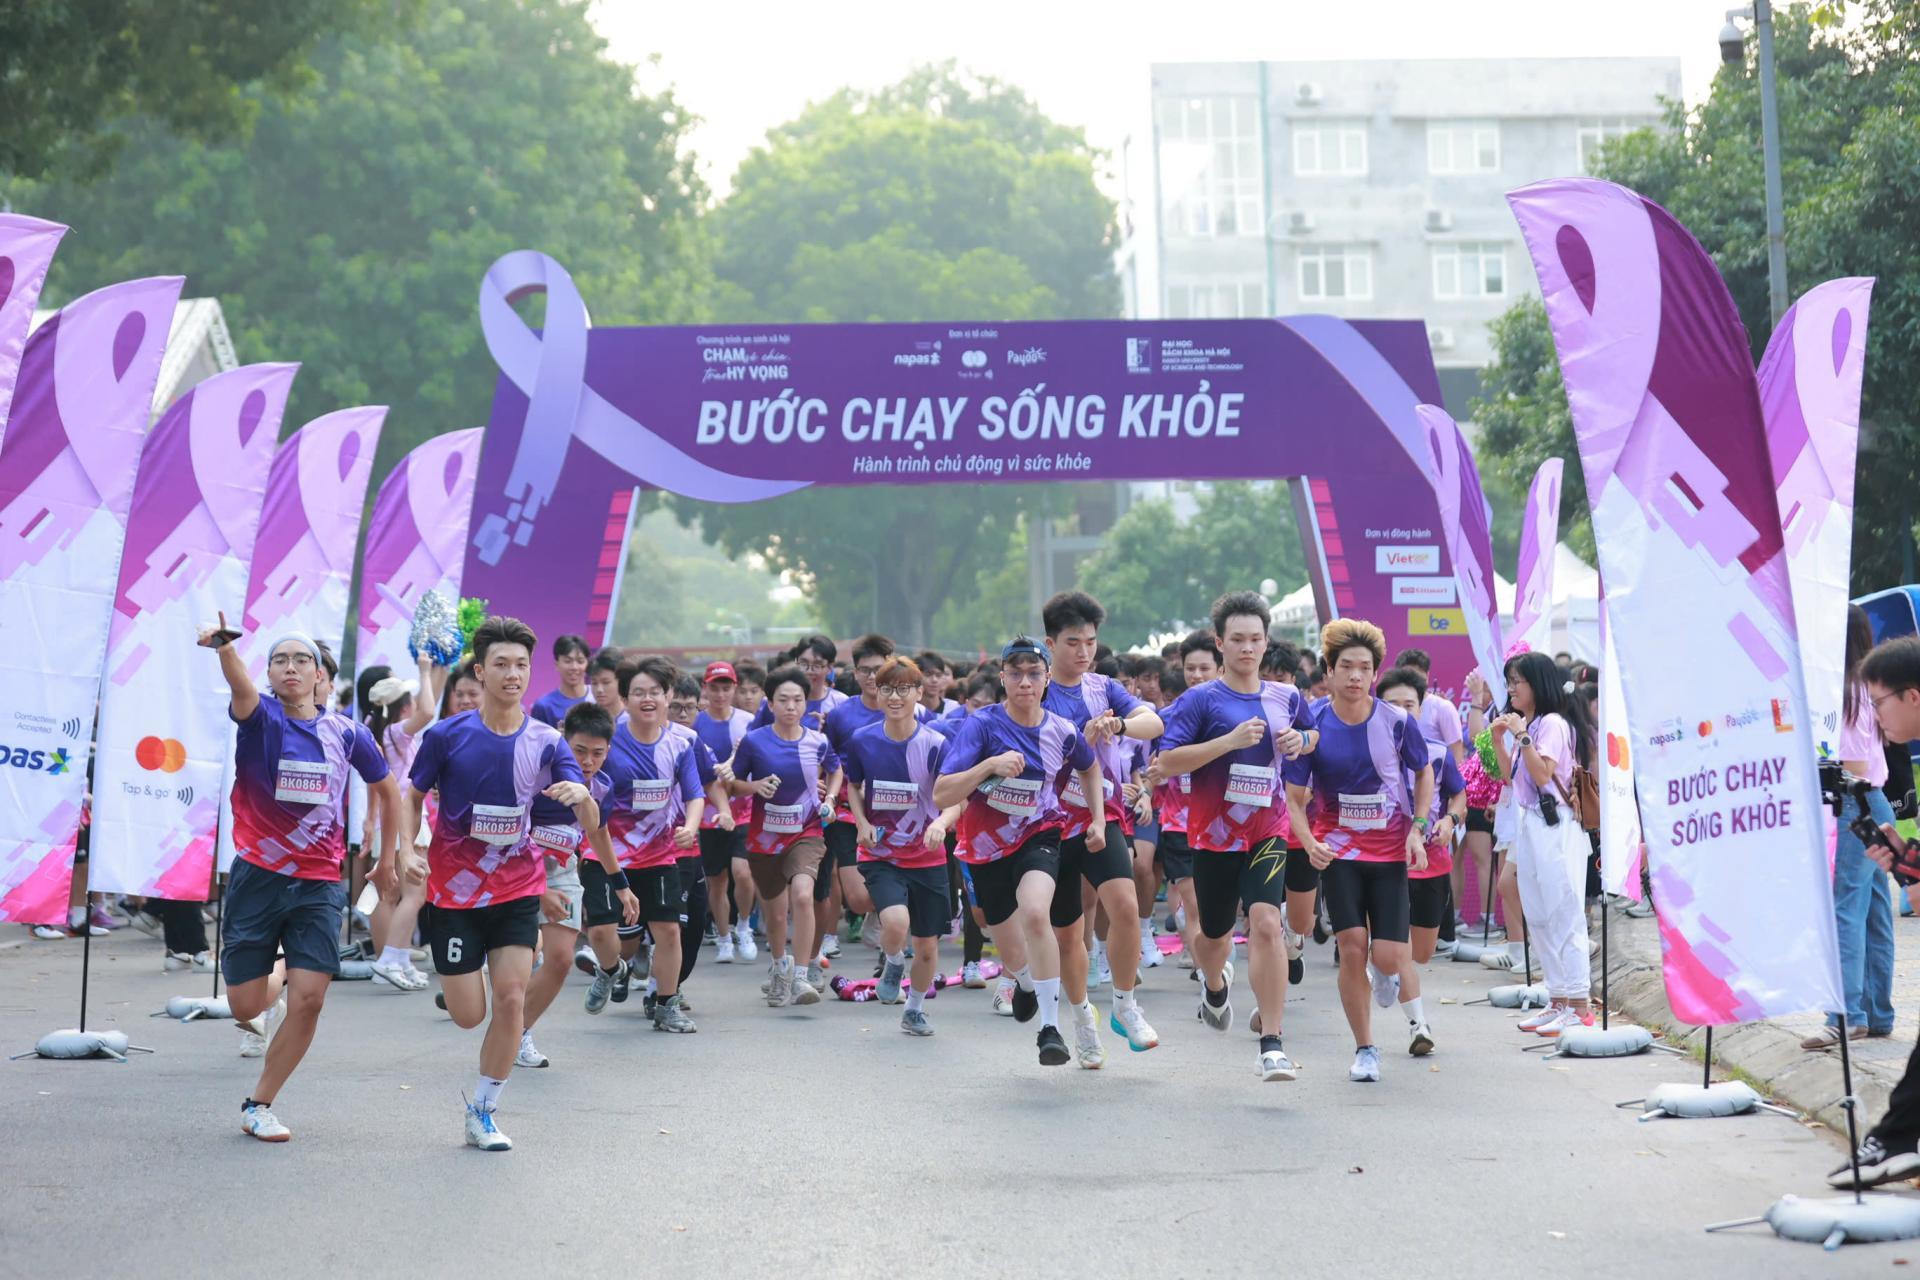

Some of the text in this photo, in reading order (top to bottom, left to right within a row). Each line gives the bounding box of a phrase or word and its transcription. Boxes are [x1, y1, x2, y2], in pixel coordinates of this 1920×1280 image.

[703, 347, 745, 364] CHẠM
[894, 354, 929, 367] napas
[727, 366, 746, 380] HY
[748, 365, 788, 382] VỌNG
[696, 379, 1244, 451] BƯỚC CHẠY SỐNG KHỎE
[853, 452, 1091, 475] Hành trình chủ động vì sức khỏe
[1429, 614, 1449, 630] be
[1649, 730, 1676, 747] napas
[281, 777, 322, 792] BK0865
[1230, 780, 1268, 795] BK0507
[1668, 757, 1786, 806] BƯỚC CHẠY
[122, 782, 169, 800] Tap & go
[992, 790, 1030, 806] BK0464
[1341, 807, 1378, 819] BK0803
[1670, 793, 1791, 847] SỐNG KHỎE
[475, 821, 517, 833] BK0823
[447, 937, 463, 963] 6
